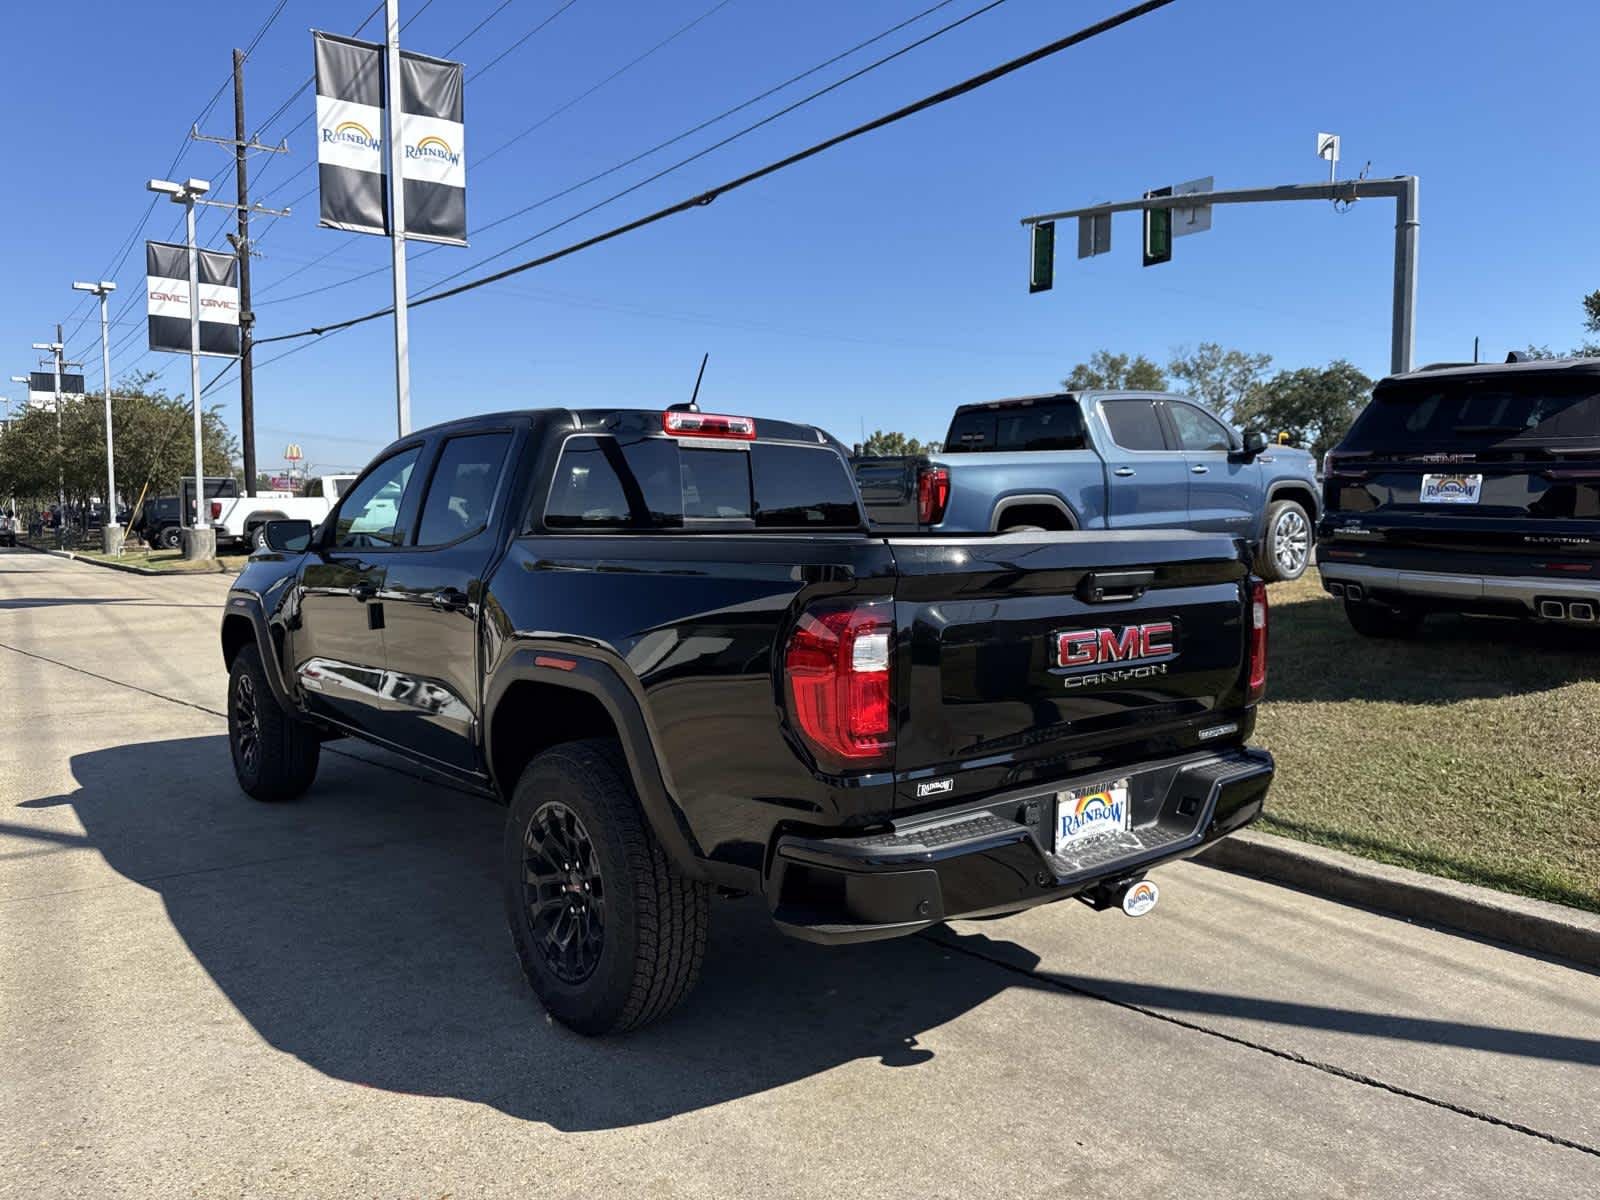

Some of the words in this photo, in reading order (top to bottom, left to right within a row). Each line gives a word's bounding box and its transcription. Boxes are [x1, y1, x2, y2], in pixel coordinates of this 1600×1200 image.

[322, 128, 383, 152] RAINBOW
[405, 144, 460, 166] RAINBOW
[150, 291, 188, 304] GMC
[200, 299, 237, 310] GMC
[1427, 485, 1477, 496] RAINBOW
[1057, 621, 1174, 668] GMC
[1064, 663, 1168, 688] CANYON
[1061, 801, 1124, 838] RAINBOW
[1128, 891, 1155, 910] RAINBOW
